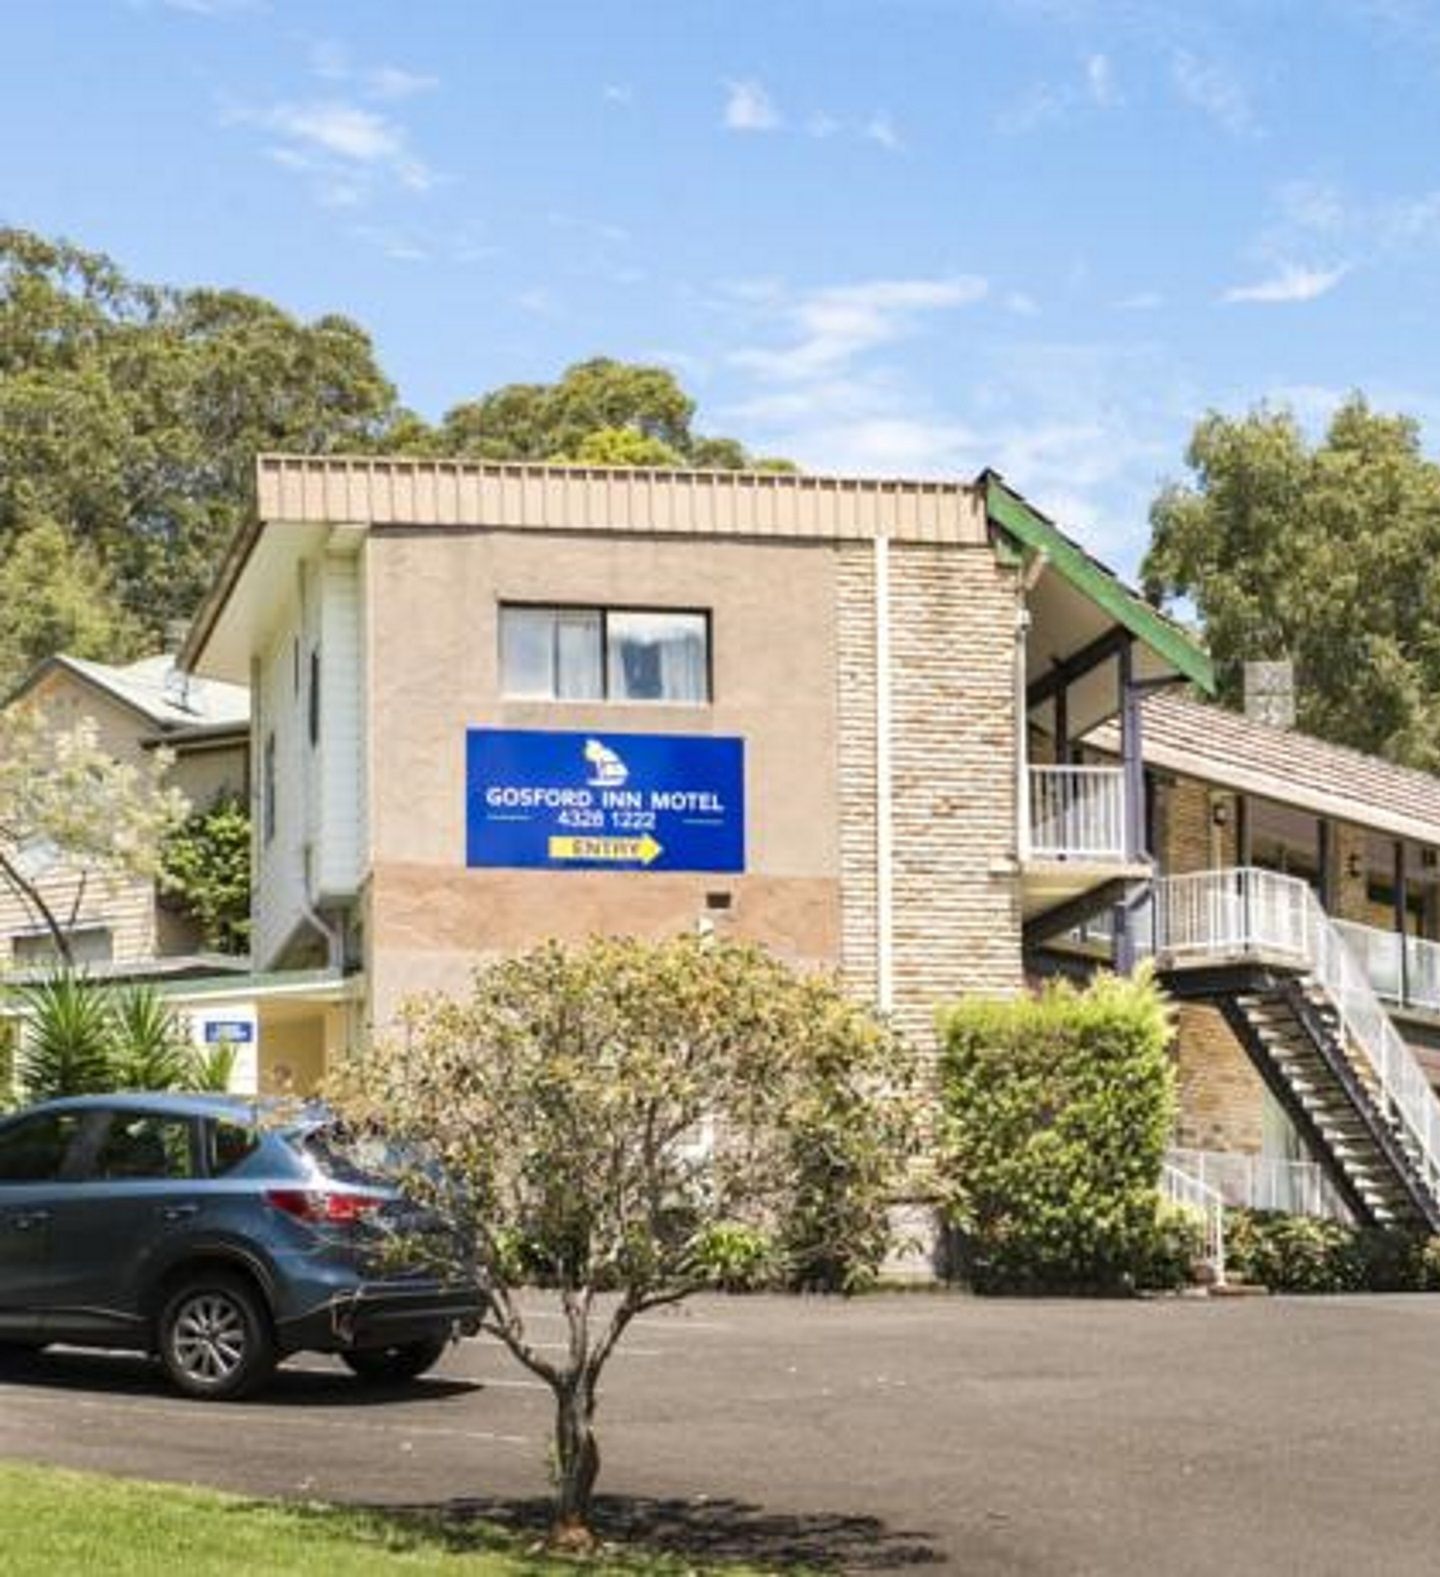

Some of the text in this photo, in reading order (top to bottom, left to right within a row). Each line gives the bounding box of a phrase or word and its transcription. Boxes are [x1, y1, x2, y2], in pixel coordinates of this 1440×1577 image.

[486, 787, 725, 812] GOSFORD INN MOTEL
[611, 811, 655, 830] 1222
[571, 839, 640, 856] ENTRY
